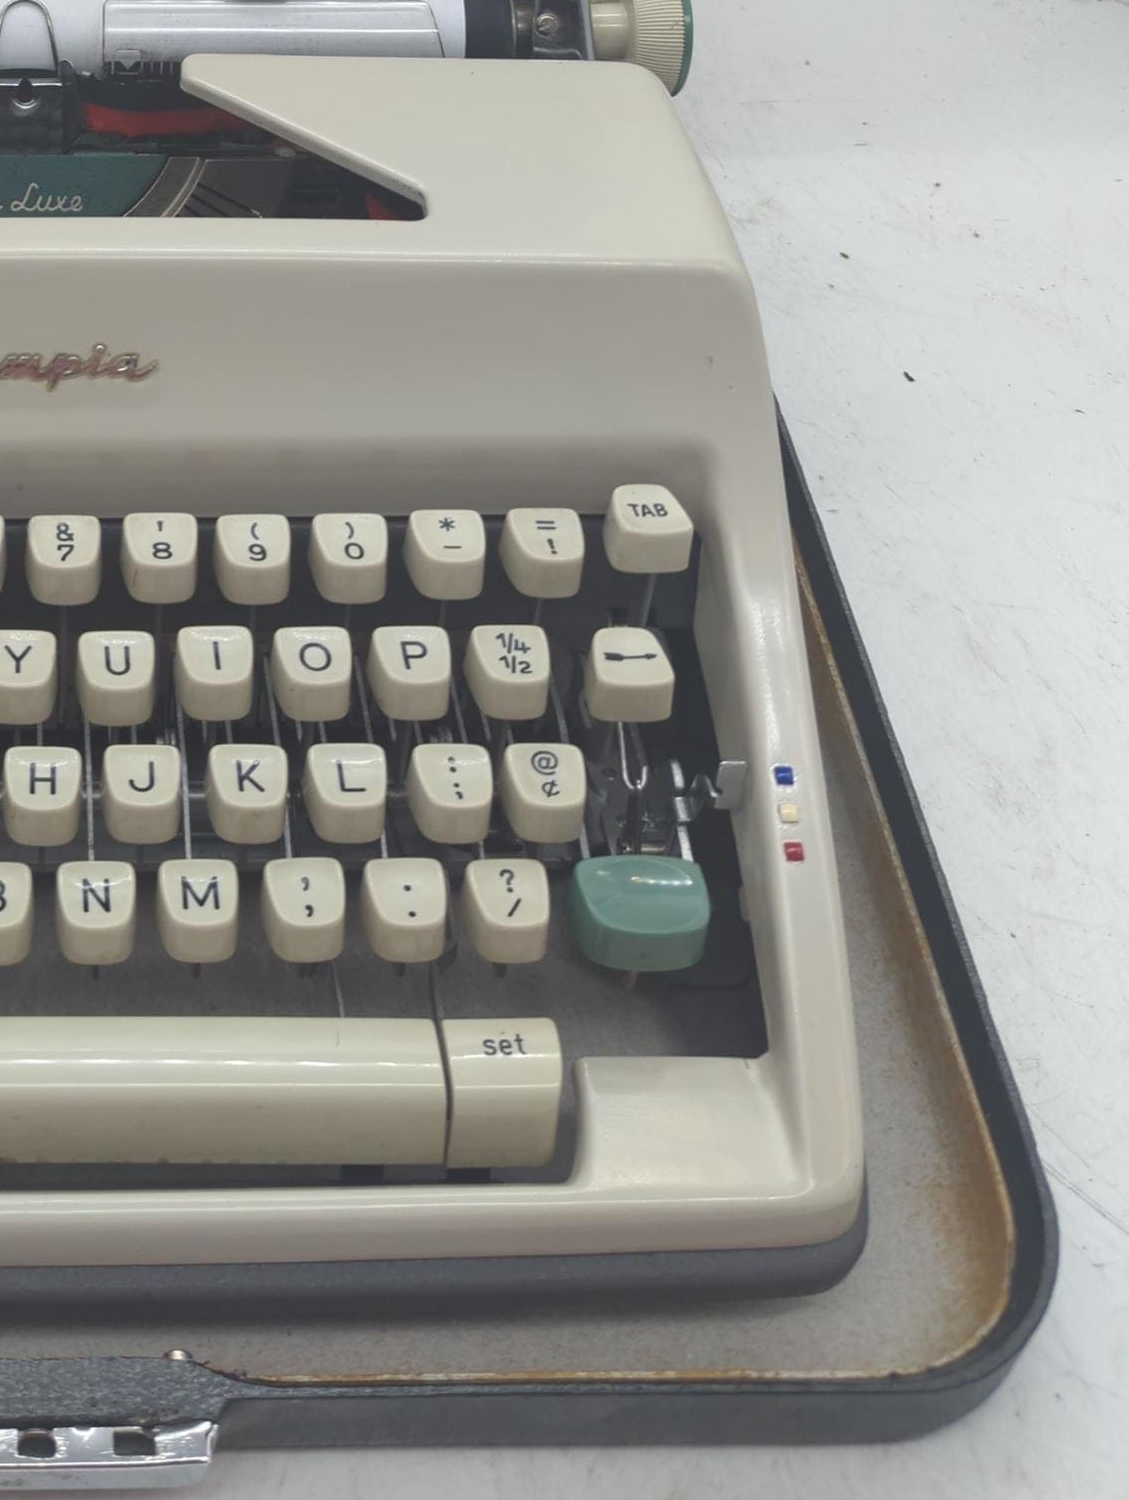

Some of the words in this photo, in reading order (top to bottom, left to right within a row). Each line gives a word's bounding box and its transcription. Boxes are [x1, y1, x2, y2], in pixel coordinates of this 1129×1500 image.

[10, 182, 84, 212] Luxe
[628, 503, 668, 518] TAB
[56, 523, 74, 541] &
[58, 545, 74, 561] 7
[152, 542, 172, 559] 8
[249, 544, 267, 561] 9
[5, 645, 32, 673] Y
[104, 646, 131, 675] U
[213, 641, 221, 669] I
[300, 643, 332, 671] O
[400, 641, 428, 669] P
[129, 761, 155, 792] J
[237, 760, 265, 792] K
[337, 760, 367, 792] L
[531, 751, 558, 775] @
[29, 763, 57, 794] H
[181, 877, 219, 910] M
[499, 869, 515, 893] ?
[82, 878, 112, 913] N
[482, 1033, 527, 1056] set
